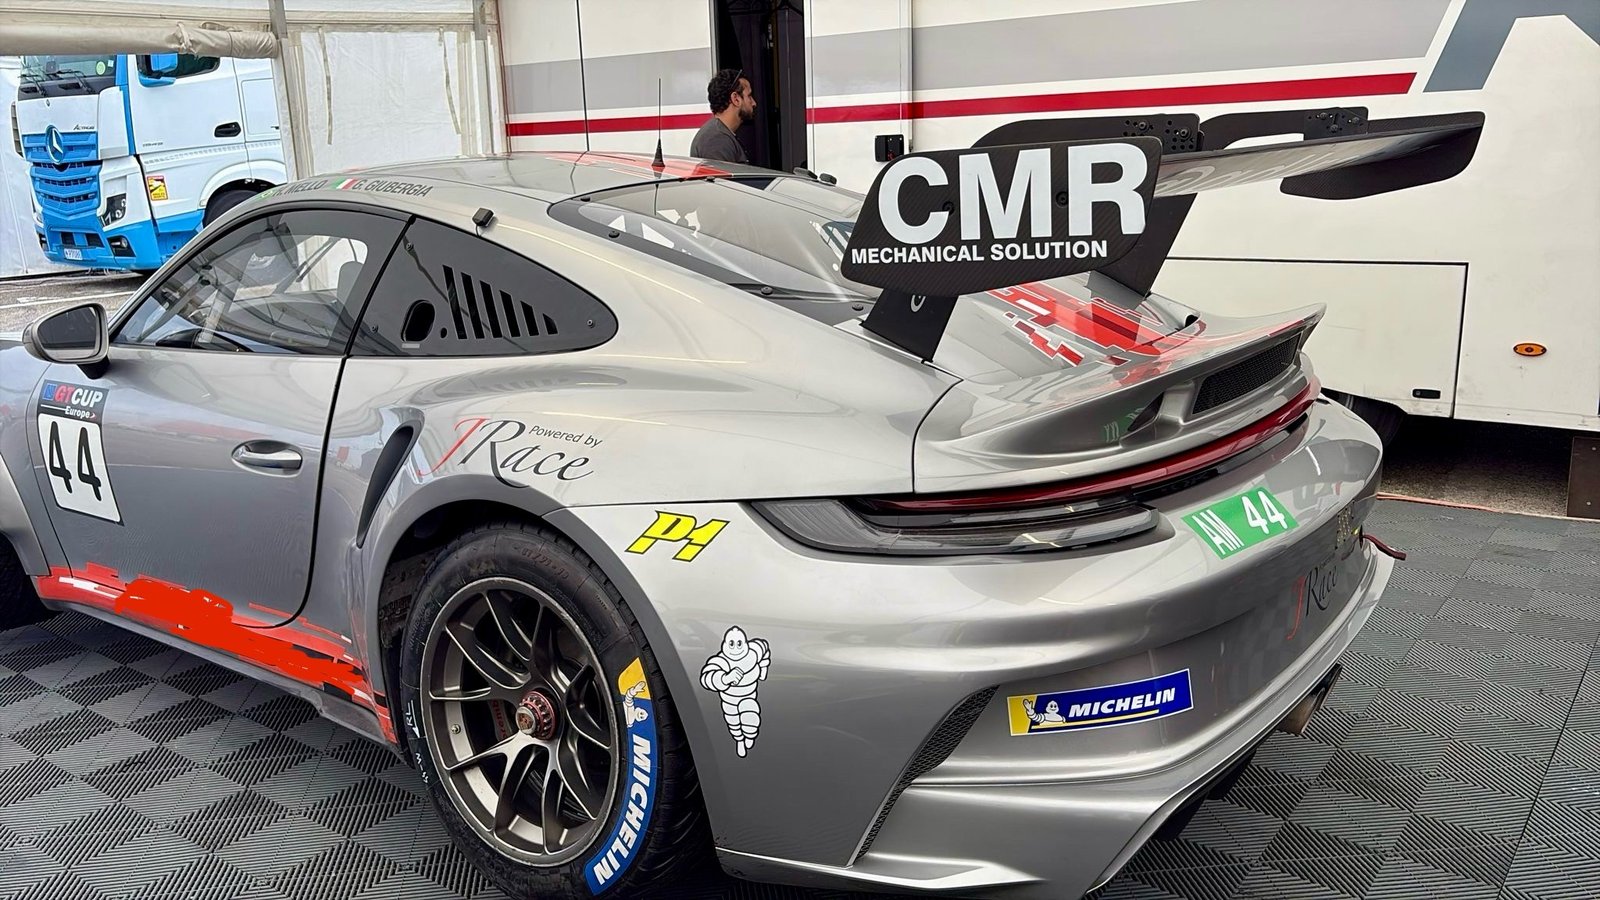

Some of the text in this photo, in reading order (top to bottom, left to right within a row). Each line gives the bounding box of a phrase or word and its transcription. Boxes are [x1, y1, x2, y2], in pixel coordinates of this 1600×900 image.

[286, 179, 329, 196] MELLO
[365, 180, 434, 197] GIUBERGIA
[878, 142, 1148, 245] CMR
[851, 240, 1108, 264] MECHANICAL SOLUTION
[64, 405, 91, 419] Europe
[528, 425, 603, 449] Powered by
[49, 421, 102, 501] 44
[624, 510, 731, 563] P1
[1192, 490, 1288, 556] AM 44
[1068, 687, 1176, 718] MICHELIN
[593, 734, 651, 885] MICHELIN
